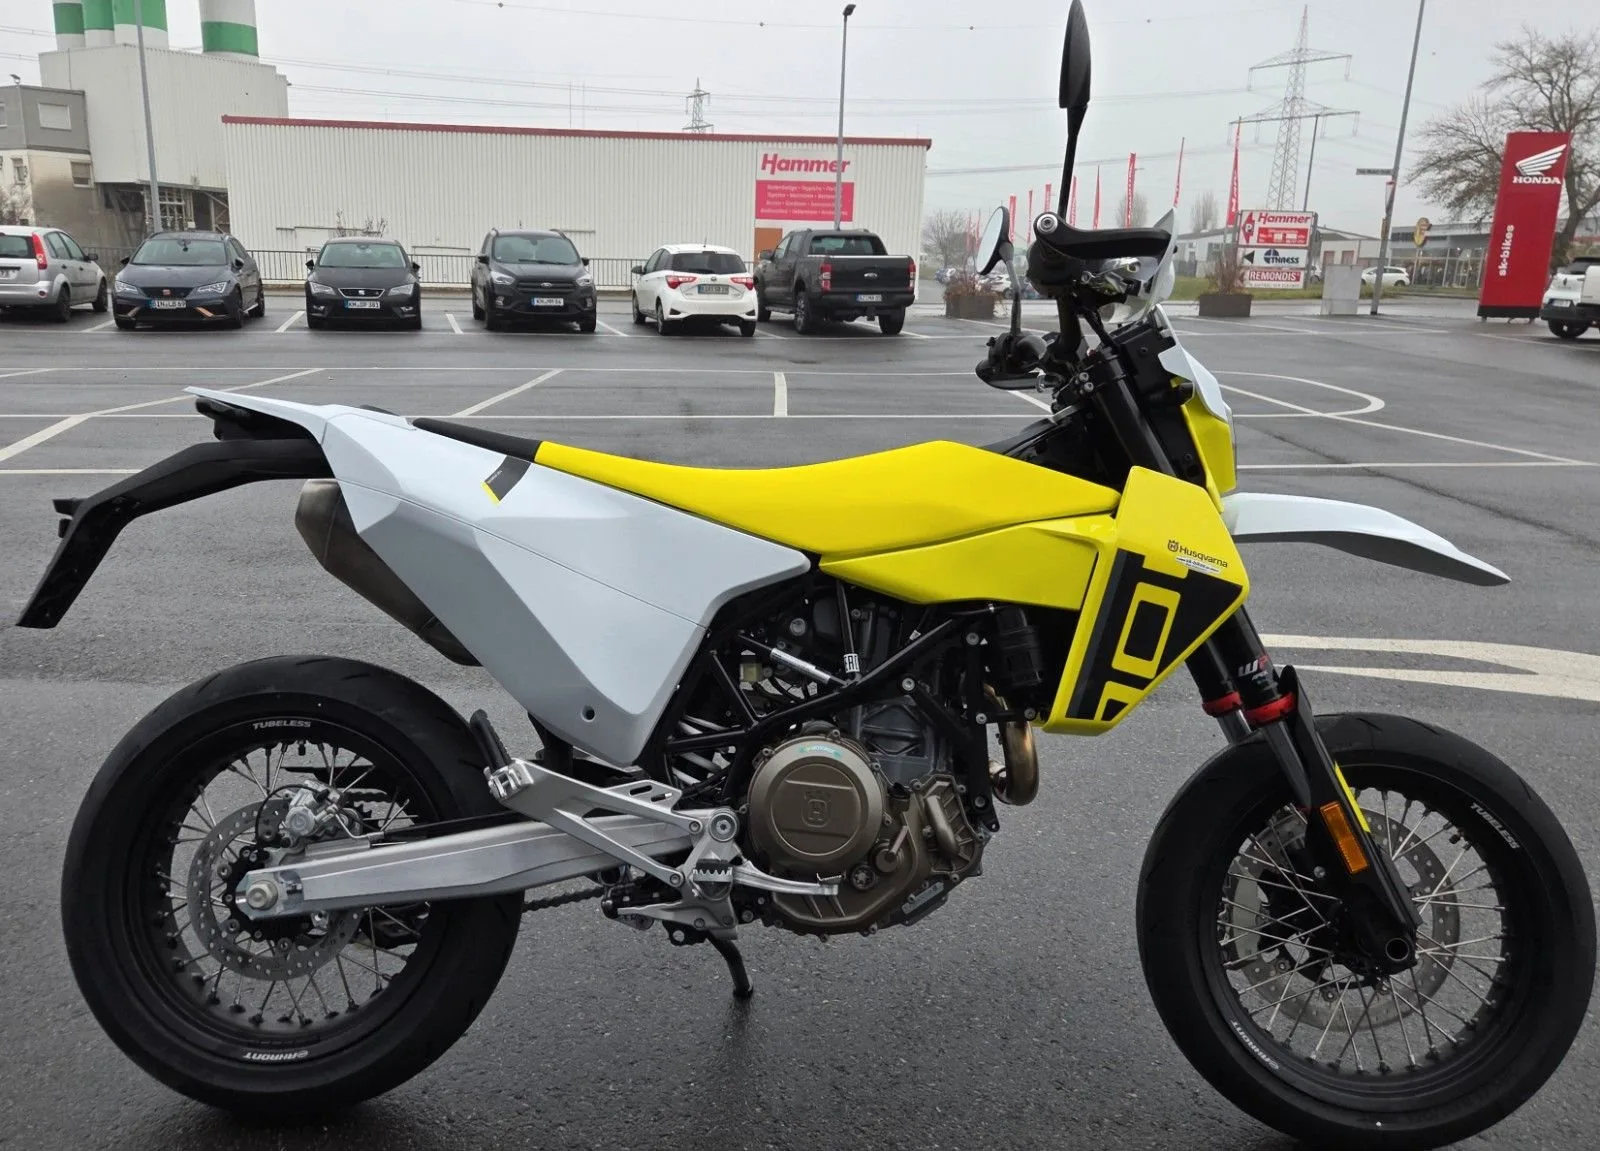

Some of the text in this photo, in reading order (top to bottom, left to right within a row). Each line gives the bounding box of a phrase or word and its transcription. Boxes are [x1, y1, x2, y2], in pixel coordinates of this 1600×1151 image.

[761, 153, 851, 175] Hammer
[1512, 176, 1562, 185] HONDA
[1258, 212, 1311, 225] Hammer
[1498, 224, 1514, 277] sk-bikes
[1250, 271, 1297, 281] REMONDIS
[1179, 545, 1228, 568] Husqvarna
[253, 720, 311, 730] TUBELESS
[1470, 803, 1520, 849] TUBELESS
